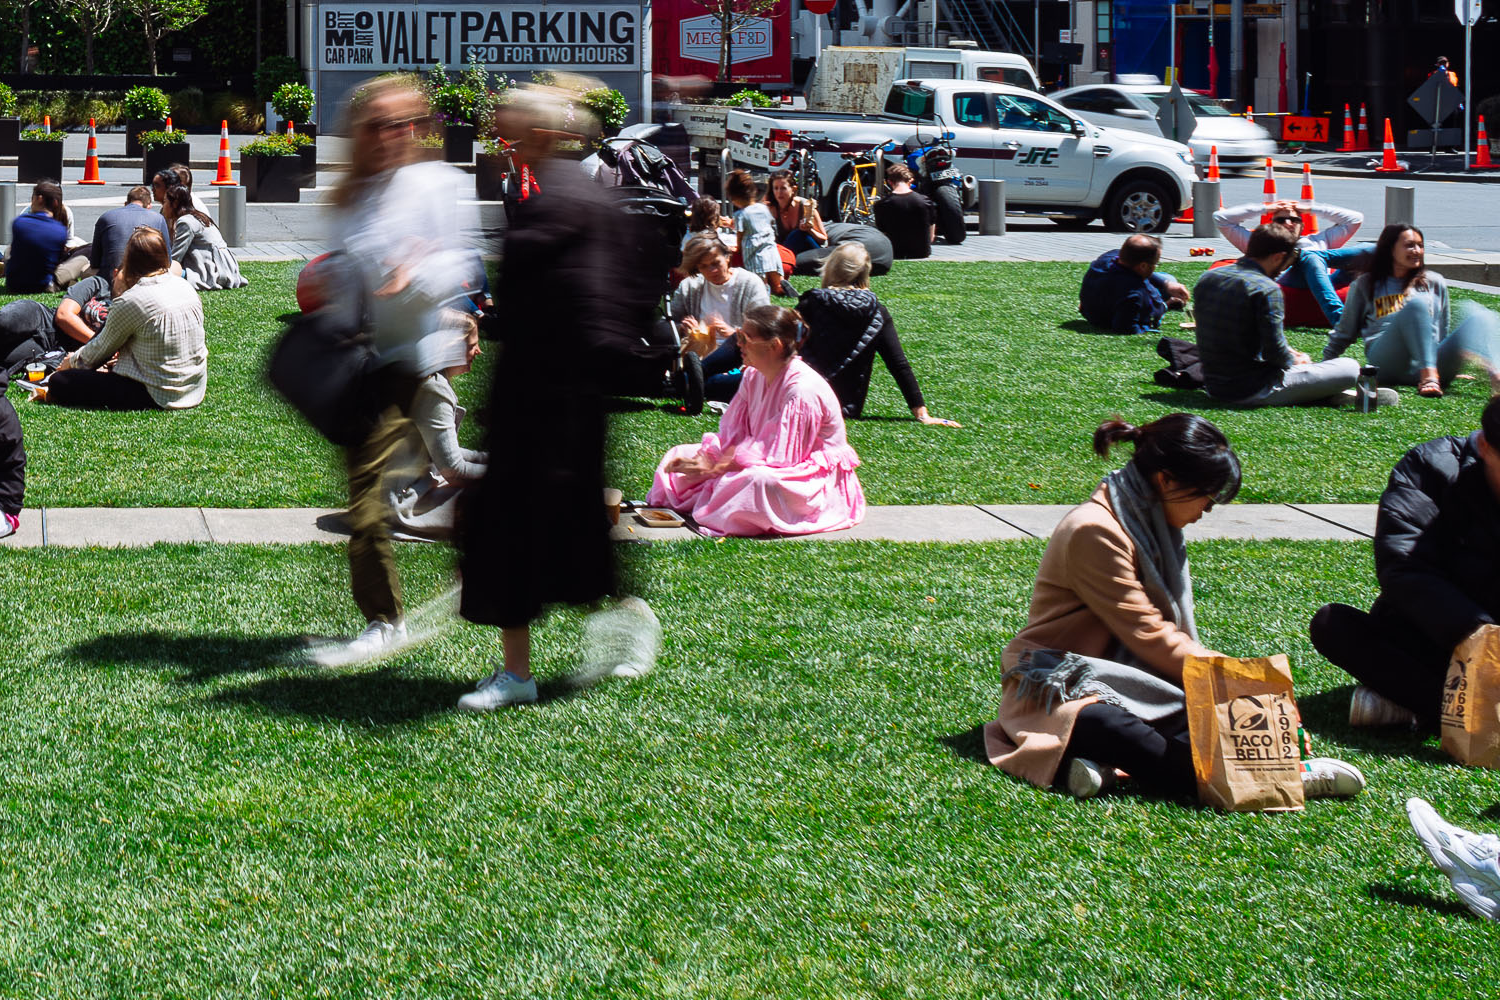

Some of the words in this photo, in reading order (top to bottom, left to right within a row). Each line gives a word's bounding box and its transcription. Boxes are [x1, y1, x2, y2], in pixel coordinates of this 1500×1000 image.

[377, 11, 456, 64] VALET
[460, 11, 635, 44] PARKING
[325, 47, 345, 64] CAR
[347, 47, 374, 64] PARK
[466, 45, 498, 63] $20
[504, 47, 533, 63] FOR
[534, 47, 571, 63] TWO
[575, 47, 628, 63] HOURS
[1017, 147, 1059, 164] JFC
[1277, 702, 1293, 759] 1962
[1230, 734, 1273, 747] TACO
[1235, 748, 1275, 761] BELL
